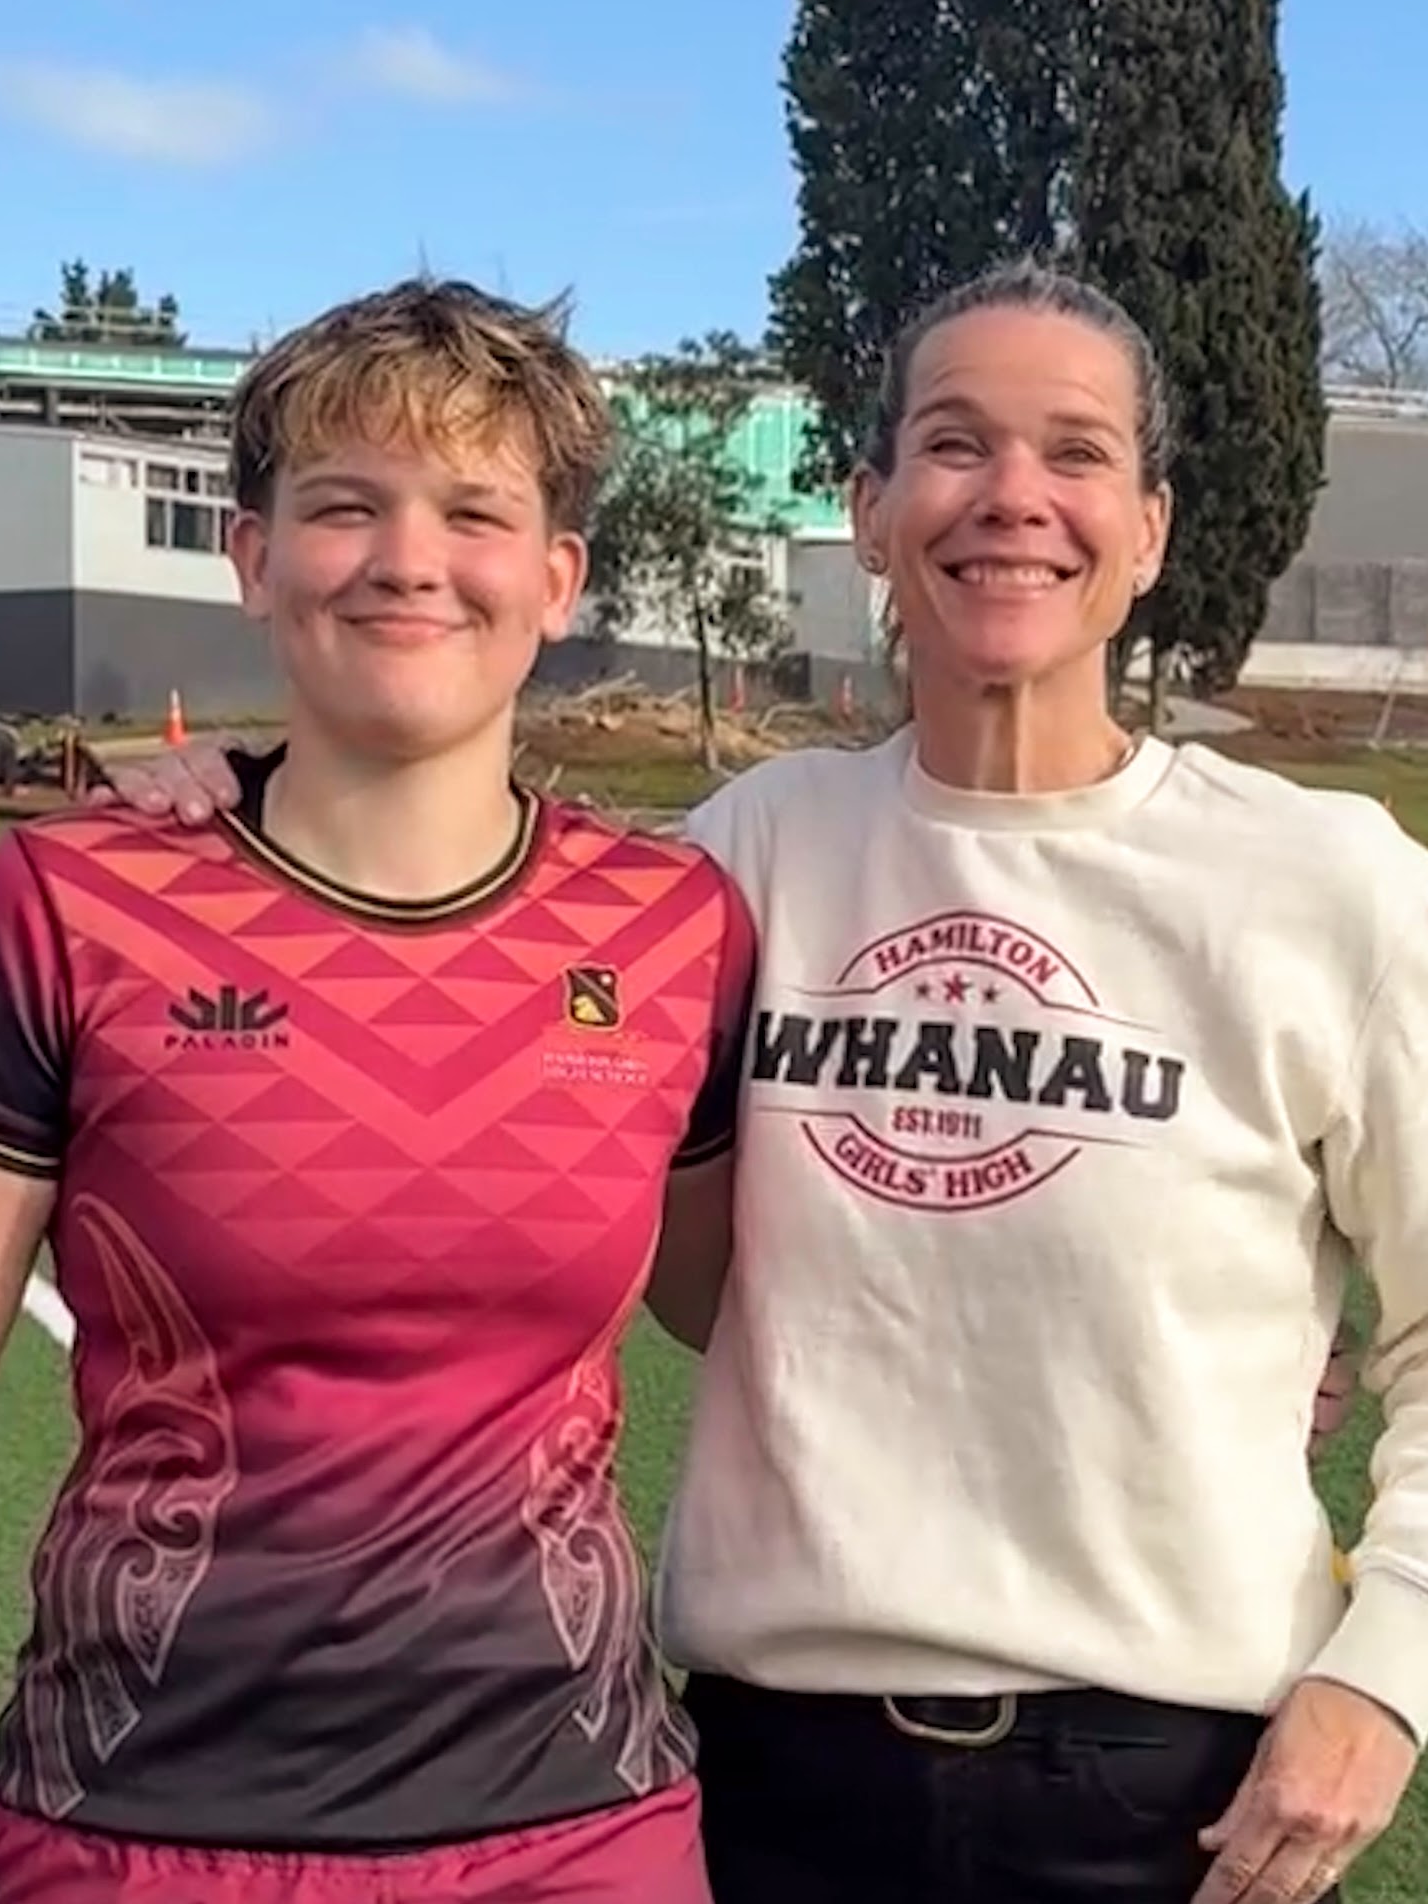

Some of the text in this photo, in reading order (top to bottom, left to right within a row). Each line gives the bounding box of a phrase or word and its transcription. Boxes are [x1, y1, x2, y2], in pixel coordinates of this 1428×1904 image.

[874, 922, 1060, 985] HAMILTON
[164, 1034, 289, 1050] PALADIN
[751, 1011, 1187, 1122] WHANAU
[944, 1150, 1033, 1198] HIGH
